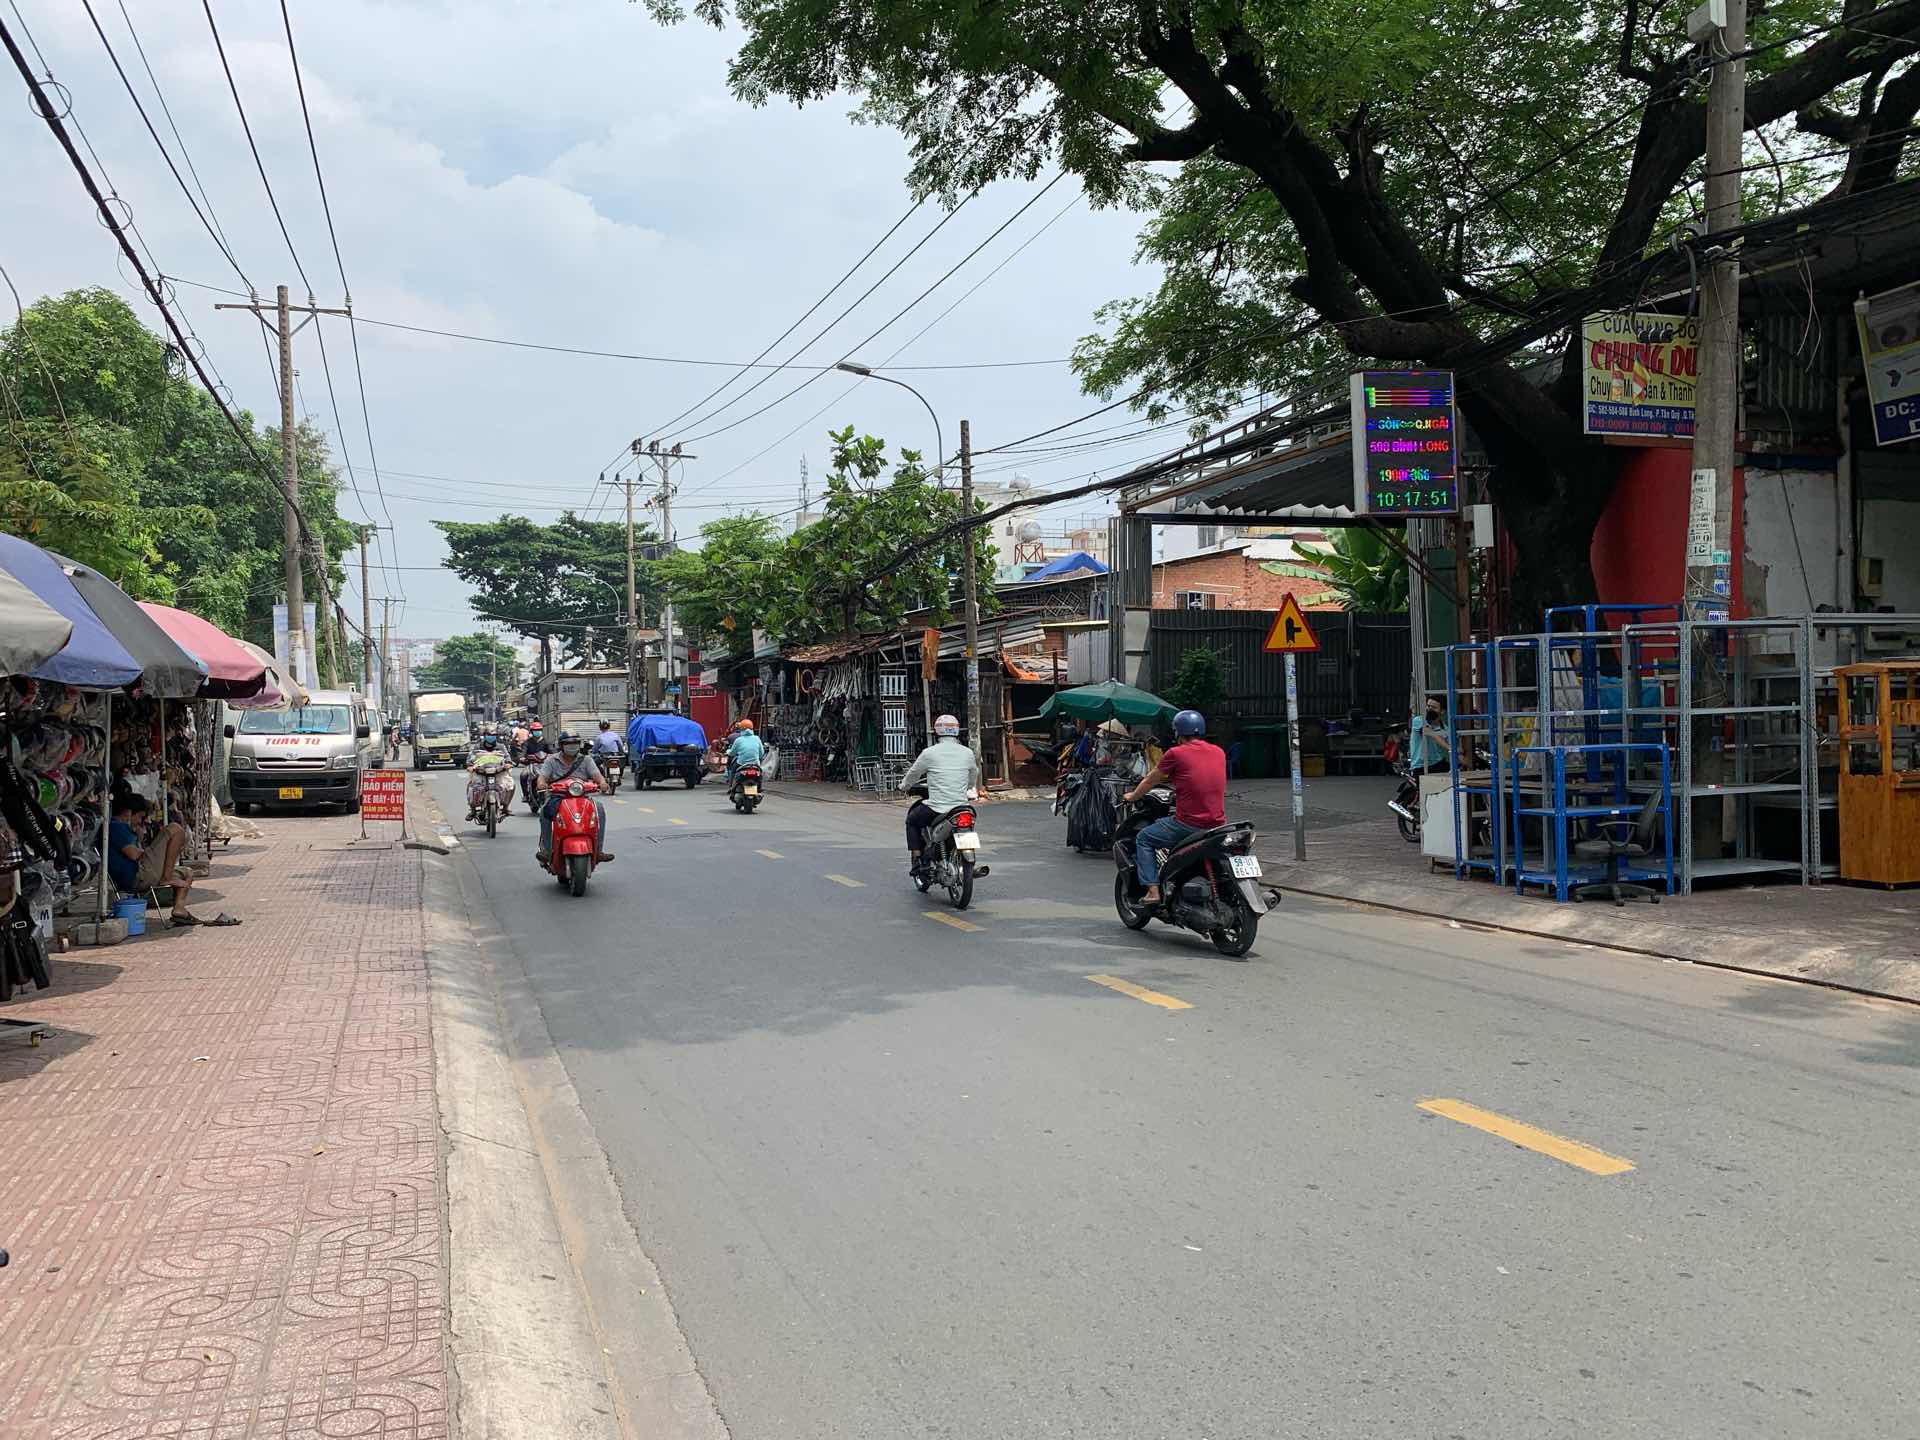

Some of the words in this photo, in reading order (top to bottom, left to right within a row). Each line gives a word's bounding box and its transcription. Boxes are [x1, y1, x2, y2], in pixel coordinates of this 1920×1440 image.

[1590, 375, 1611, 400] Chuy
[1660, 382, 1666, 401] &
[1419, 440, 1449, 453] LONG
[363, 778, 380, 791] BẢO
